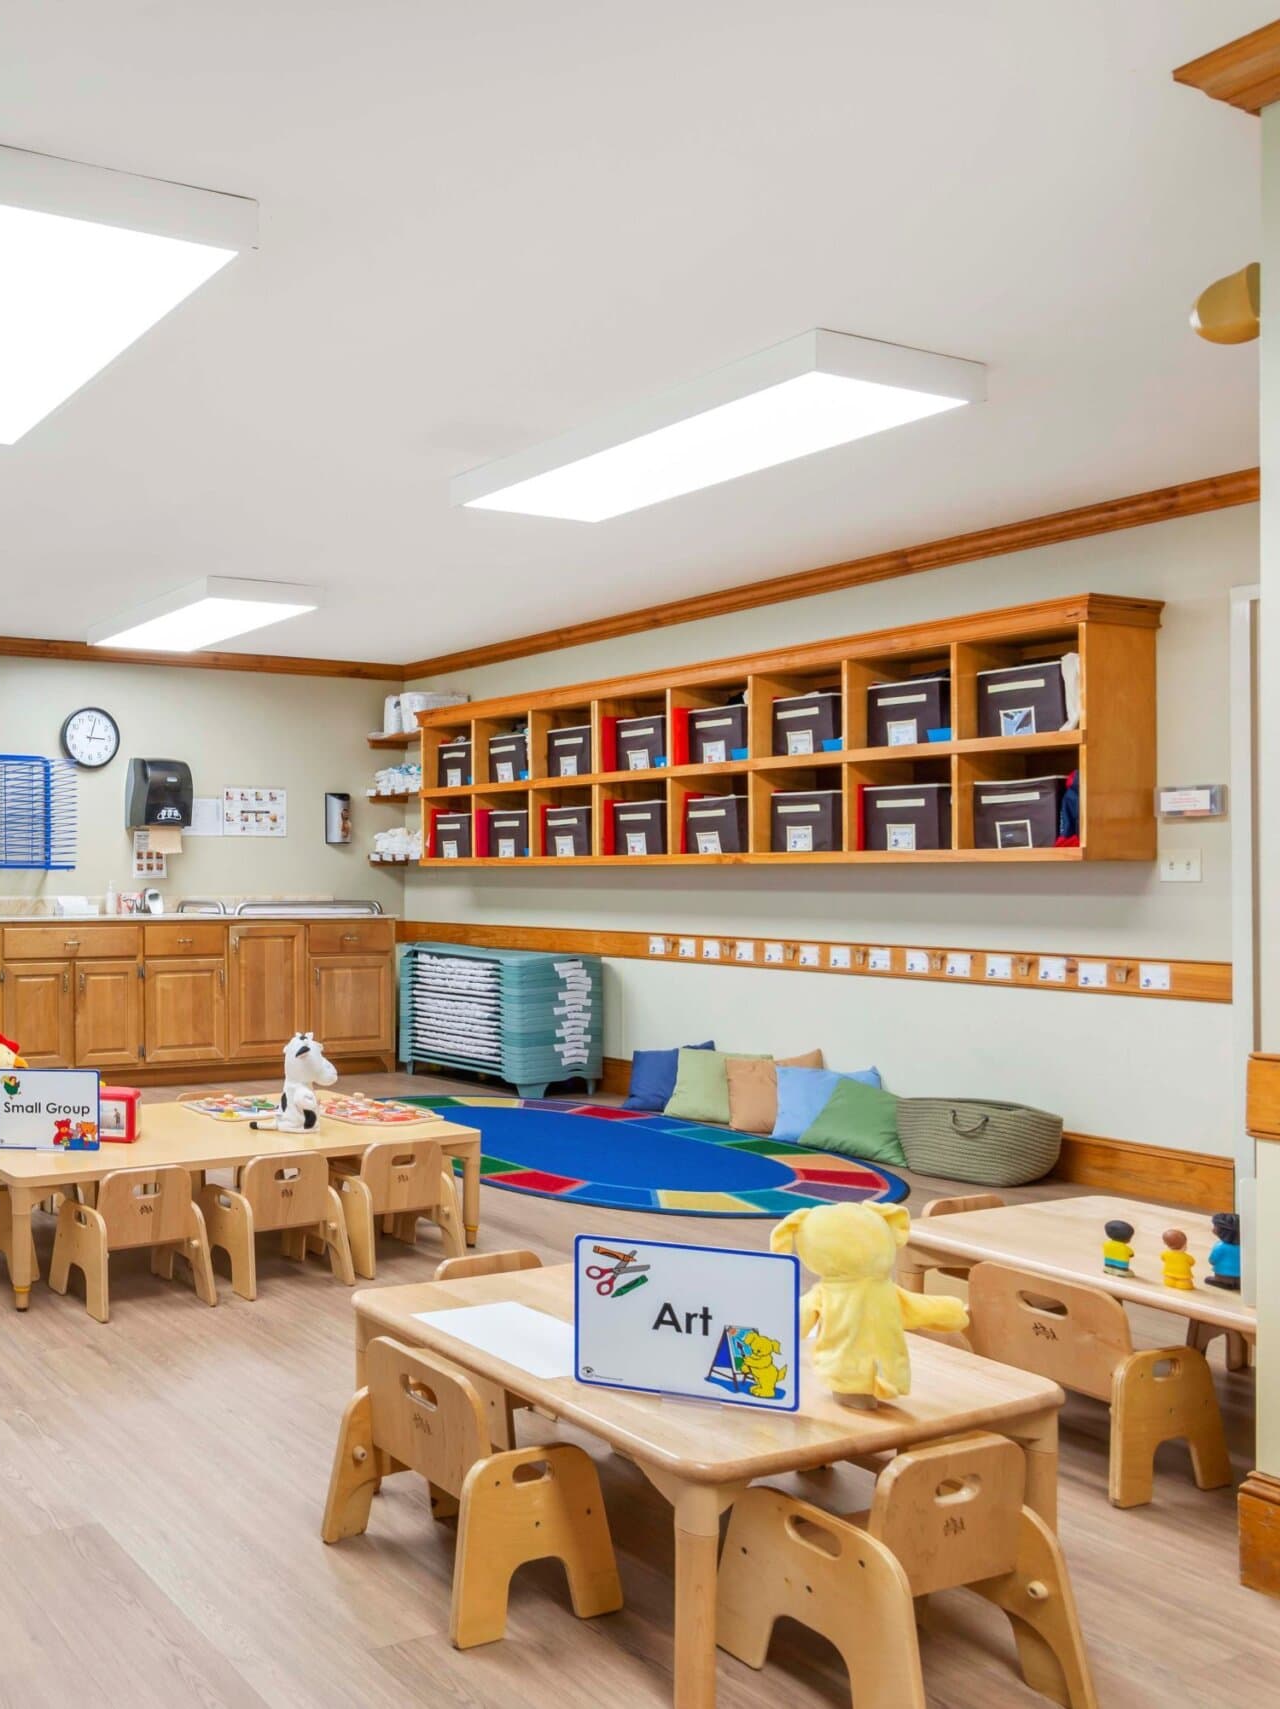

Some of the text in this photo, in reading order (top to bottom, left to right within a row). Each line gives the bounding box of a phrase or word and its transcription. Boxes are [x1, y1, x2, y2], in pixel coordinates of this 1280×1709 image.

[3, 1102, 90, 1117] Small Group
[652, 1302, 713, 1336] Art
